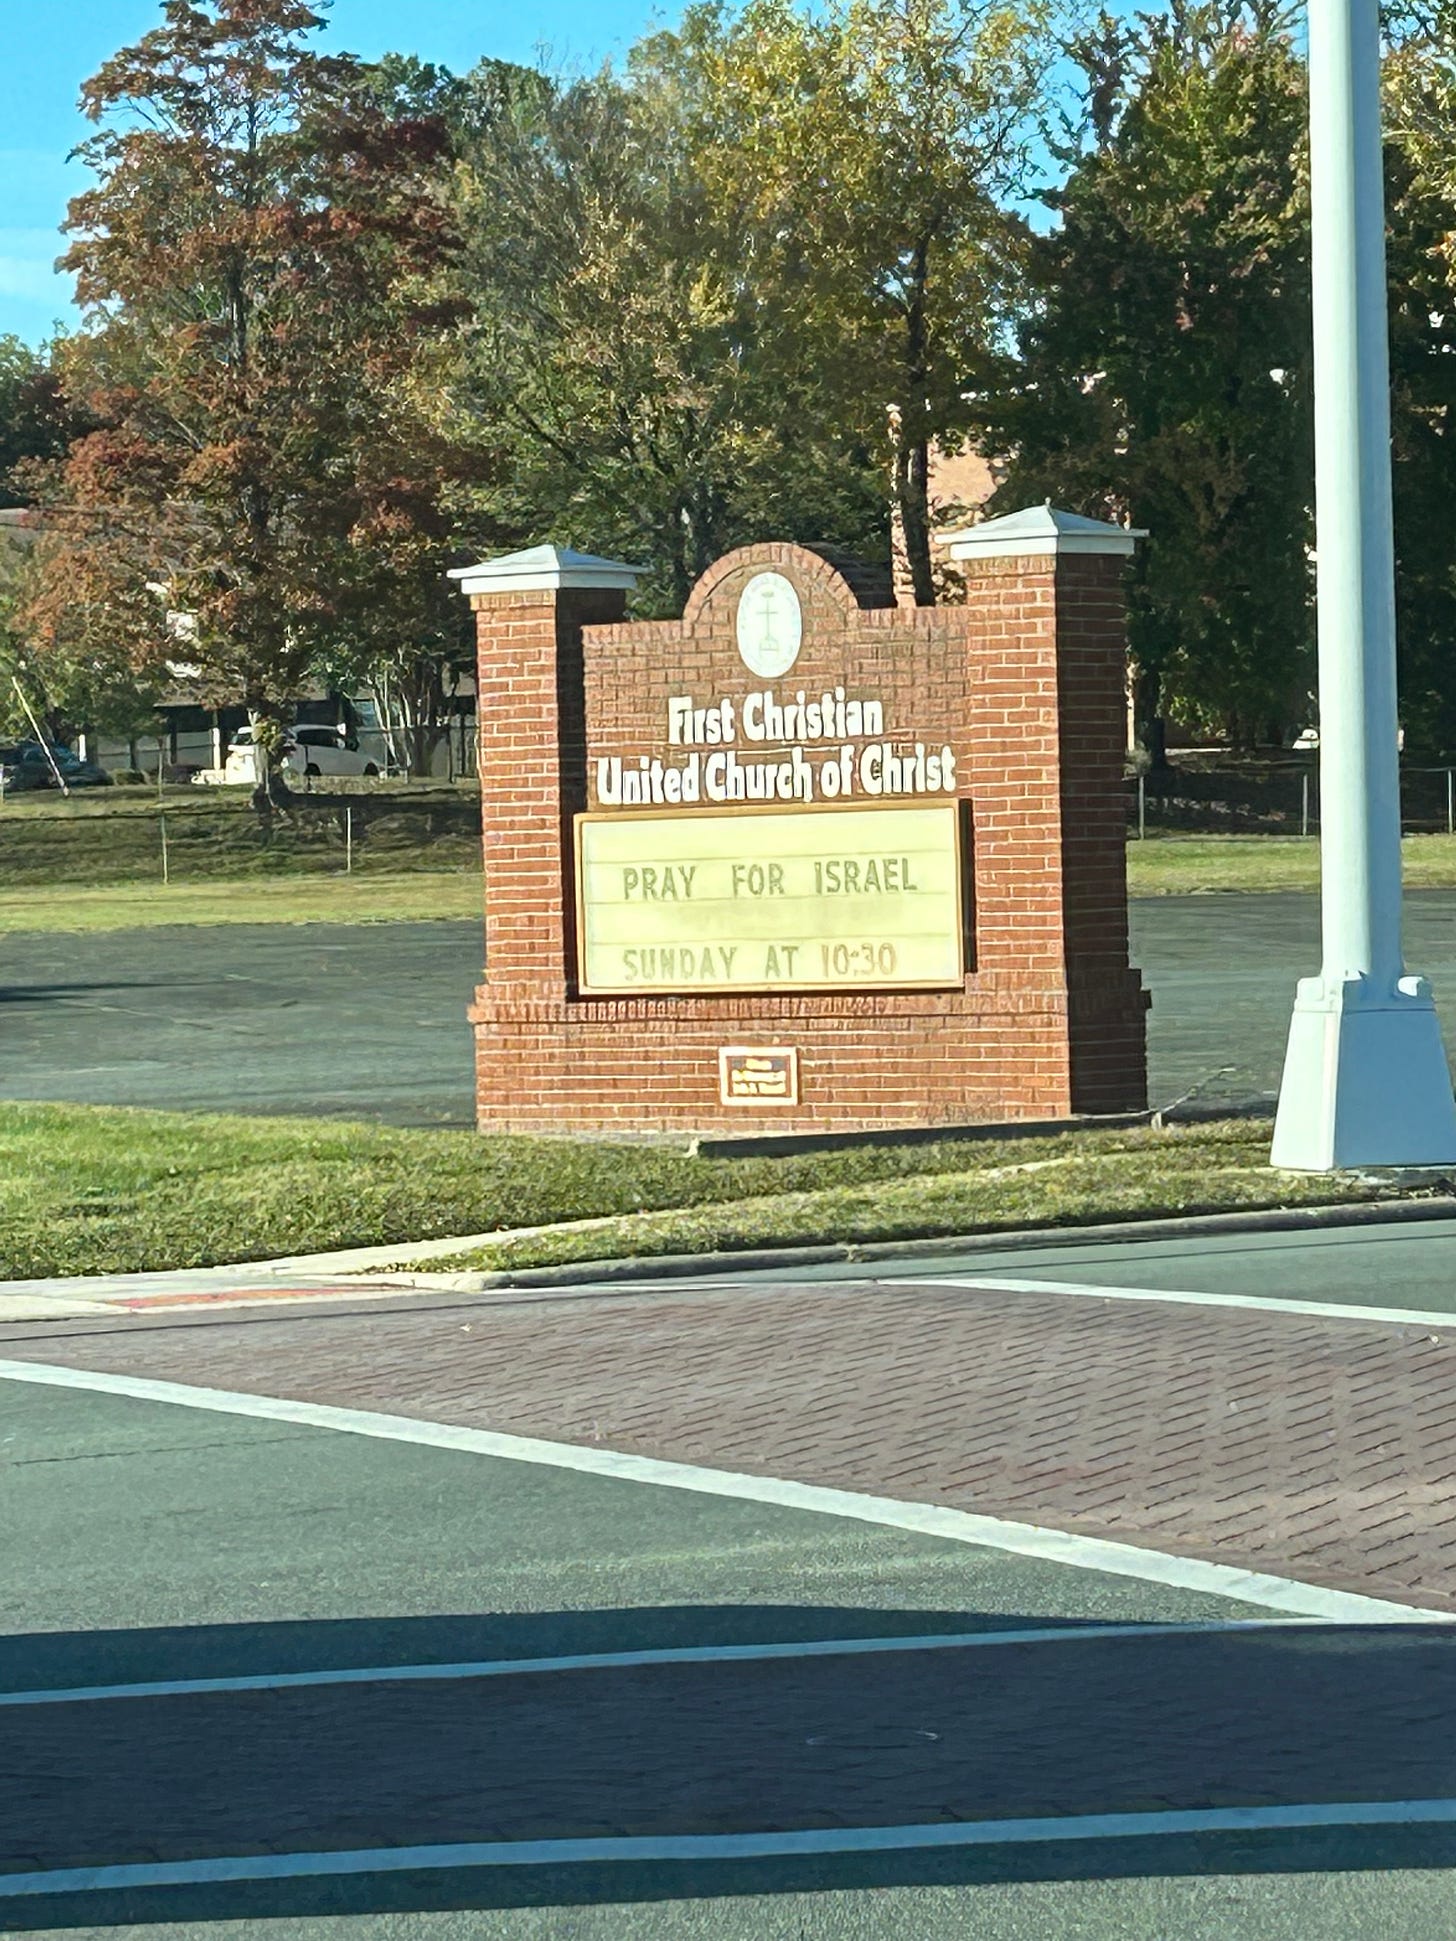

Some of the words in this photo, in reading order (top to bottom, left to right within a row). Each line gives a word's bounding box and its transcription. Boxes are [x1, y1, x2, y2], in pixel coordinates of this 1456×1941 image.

[668, 696, 734, 744] First
[742, 687, 883, 742] Christian
[597, 752, 700, 805] United
[705, 747, 813, 802] Church
[821, 744, 855, 798] of
[859, 743, 957, 795] Christ
[622, 865, 697, 901] PRAY
[732, 863, 785, 897] FOR
[815, 858, 918, 895] ISRAEL
[623, 946, 738, 981] SUNDAY
[764, 945, 799, 979] AT
